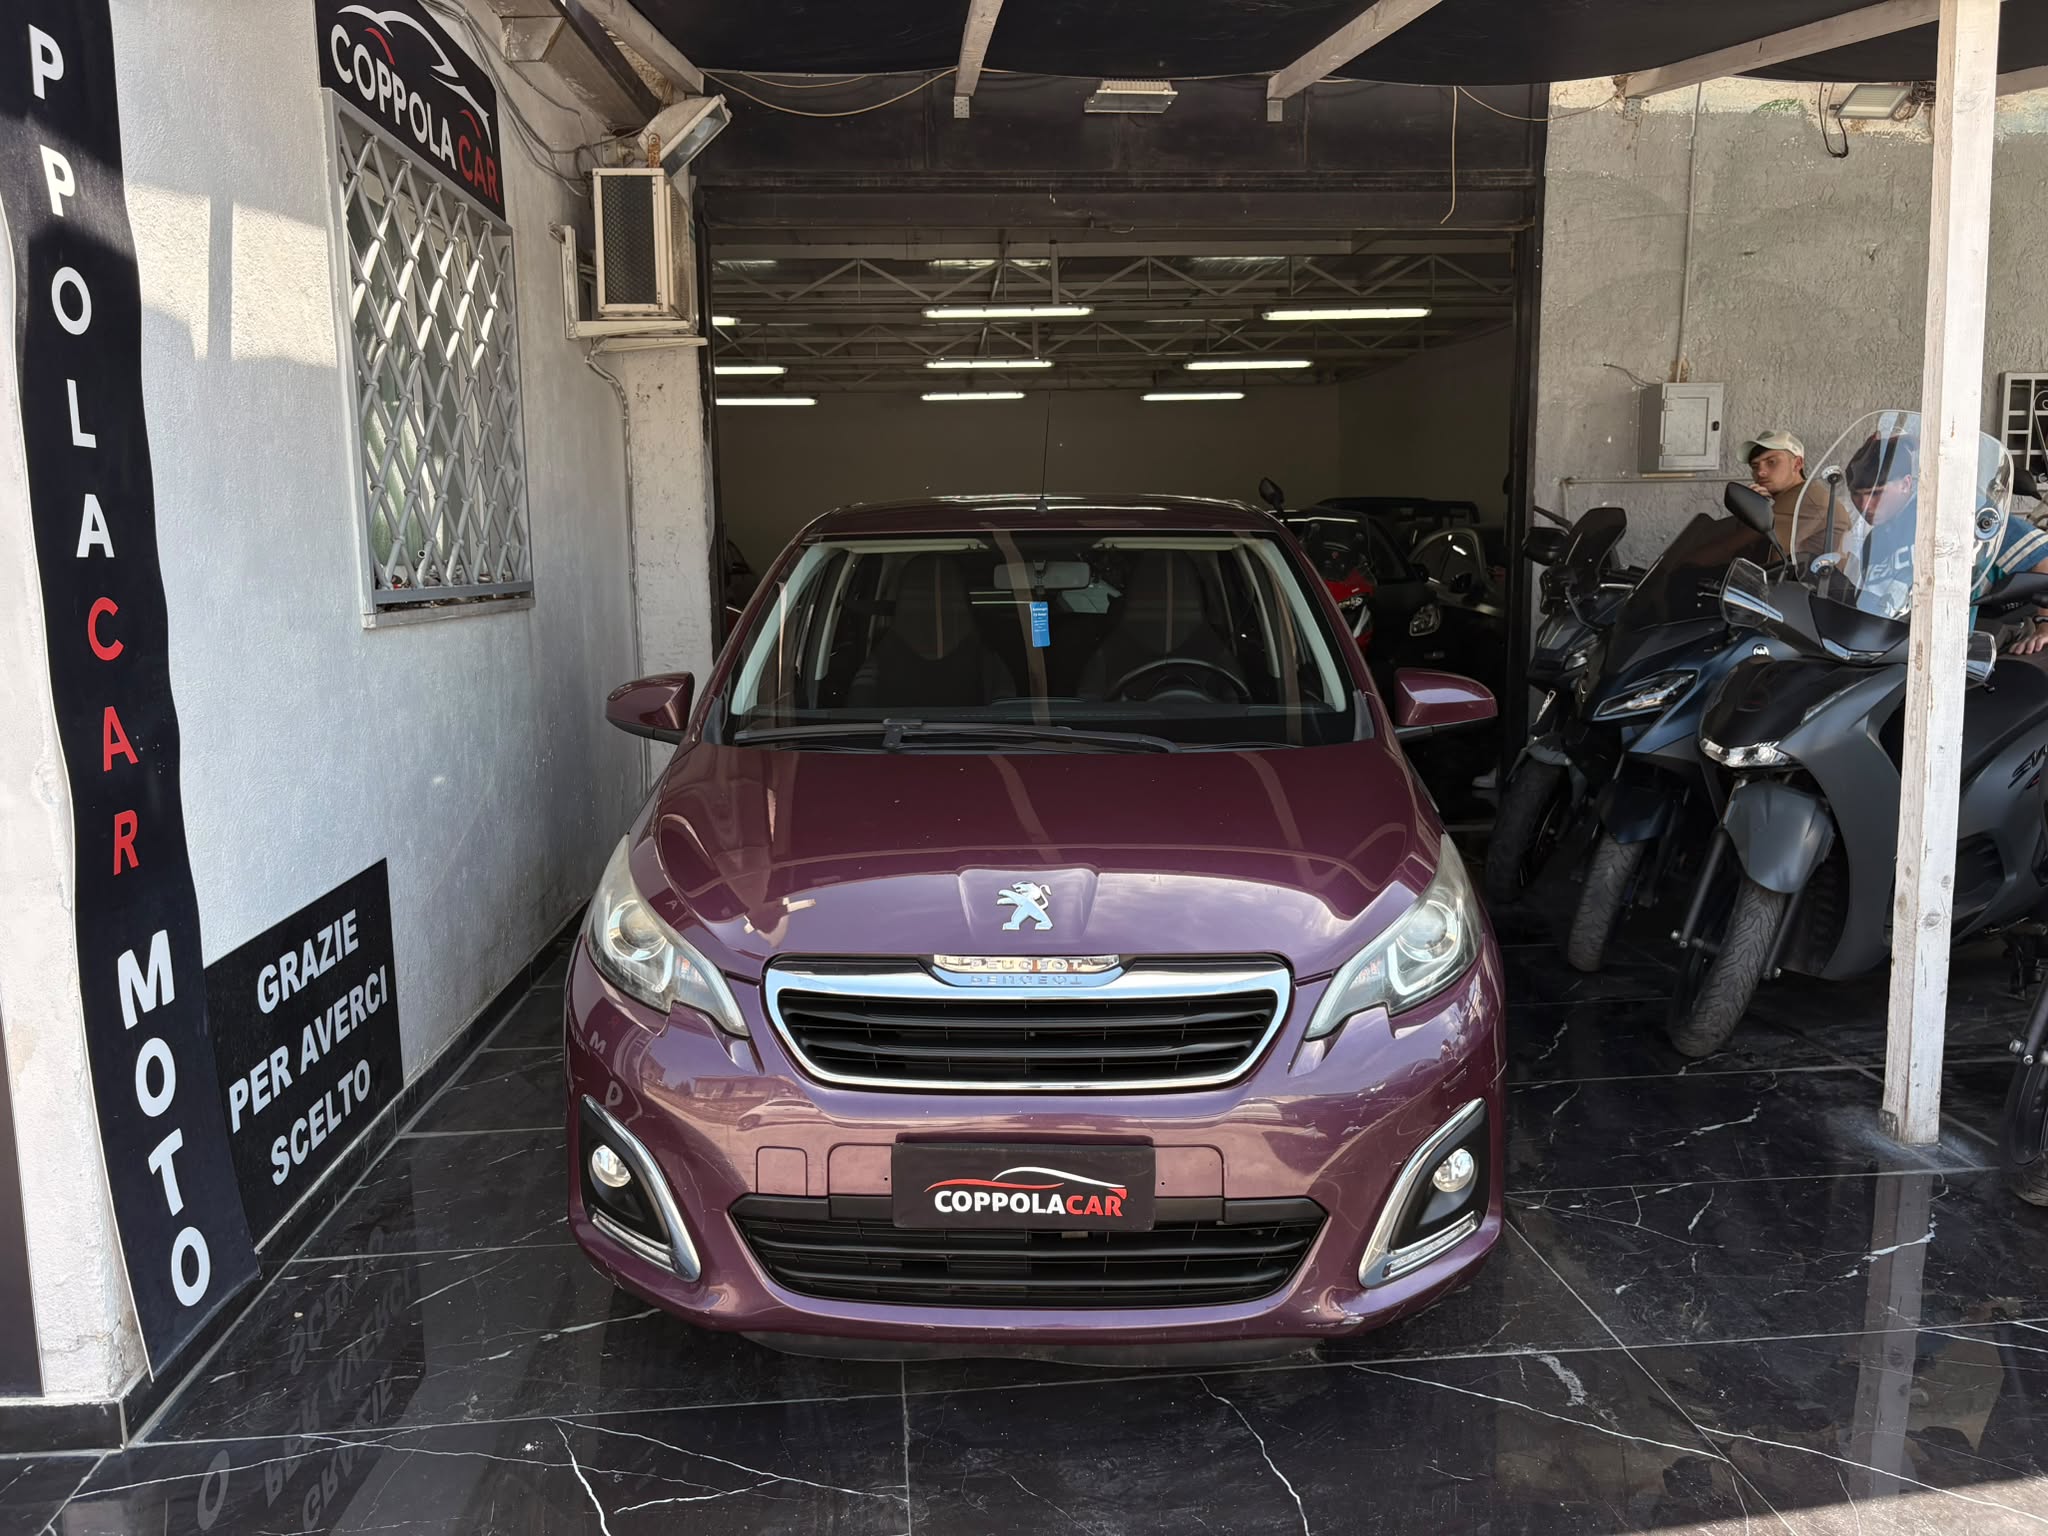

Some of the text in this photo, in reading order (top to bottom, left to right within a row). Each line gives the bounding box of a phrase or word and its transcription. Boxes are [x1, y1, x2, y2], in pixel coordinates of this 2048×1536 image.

[257, 908, 360, 1015] GRAZIE
[970, 958, 1083, 971] PEUGEOT
[228, 964, 388, 1135] PER AVERCI
[117, 929, 211, 1307] MOTO
[270, 1058, 371, 1187] SCELTO
